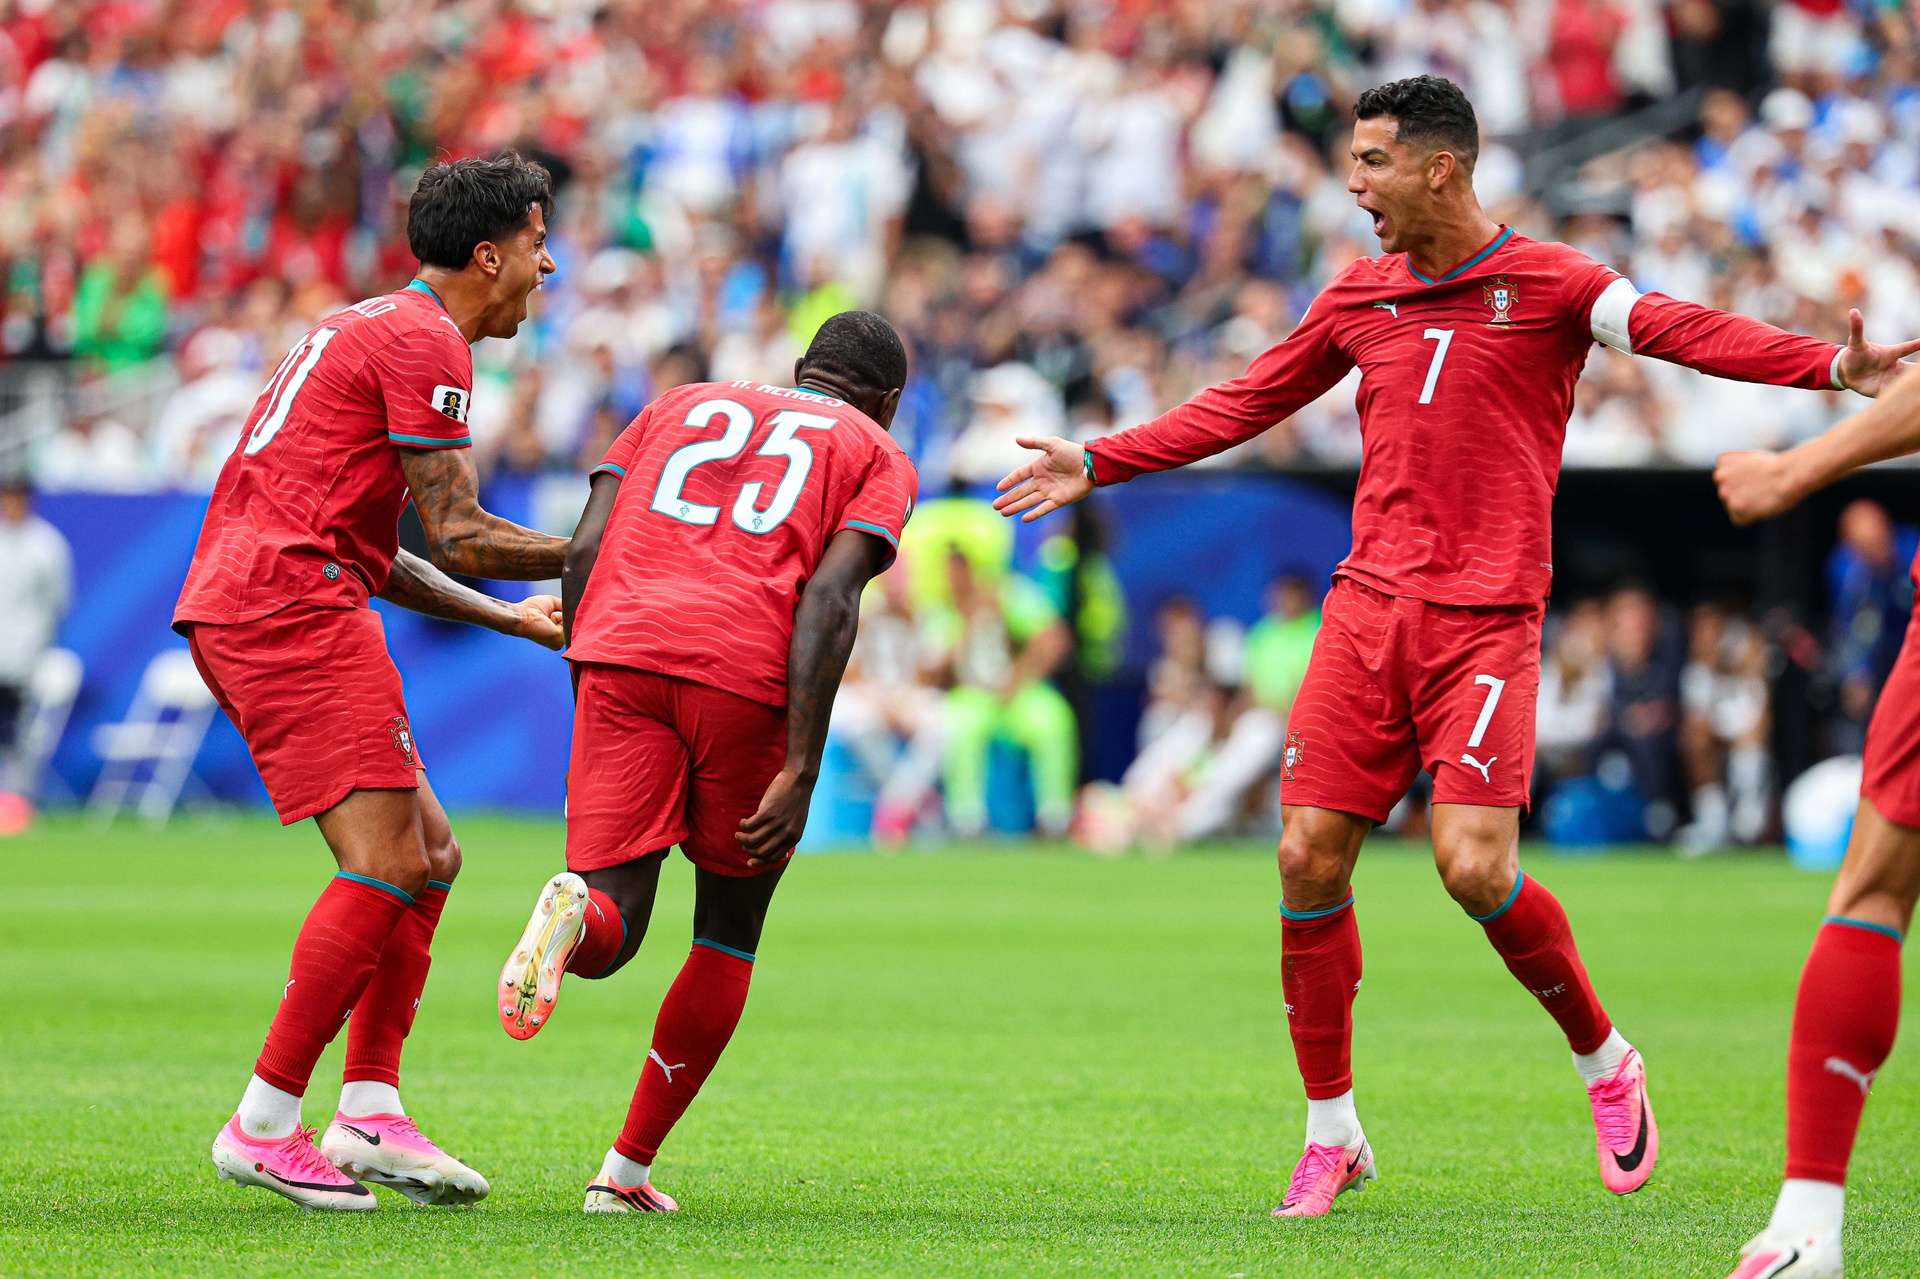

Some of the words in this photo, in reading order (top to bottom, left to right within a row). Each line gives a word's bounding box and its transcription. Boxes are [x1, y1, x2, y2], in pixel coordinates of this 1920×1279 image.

[1418, 328, 1455, 405] 7
[650, 398, 840, 535] 25
[1466, 673, 1506, 748] 7
